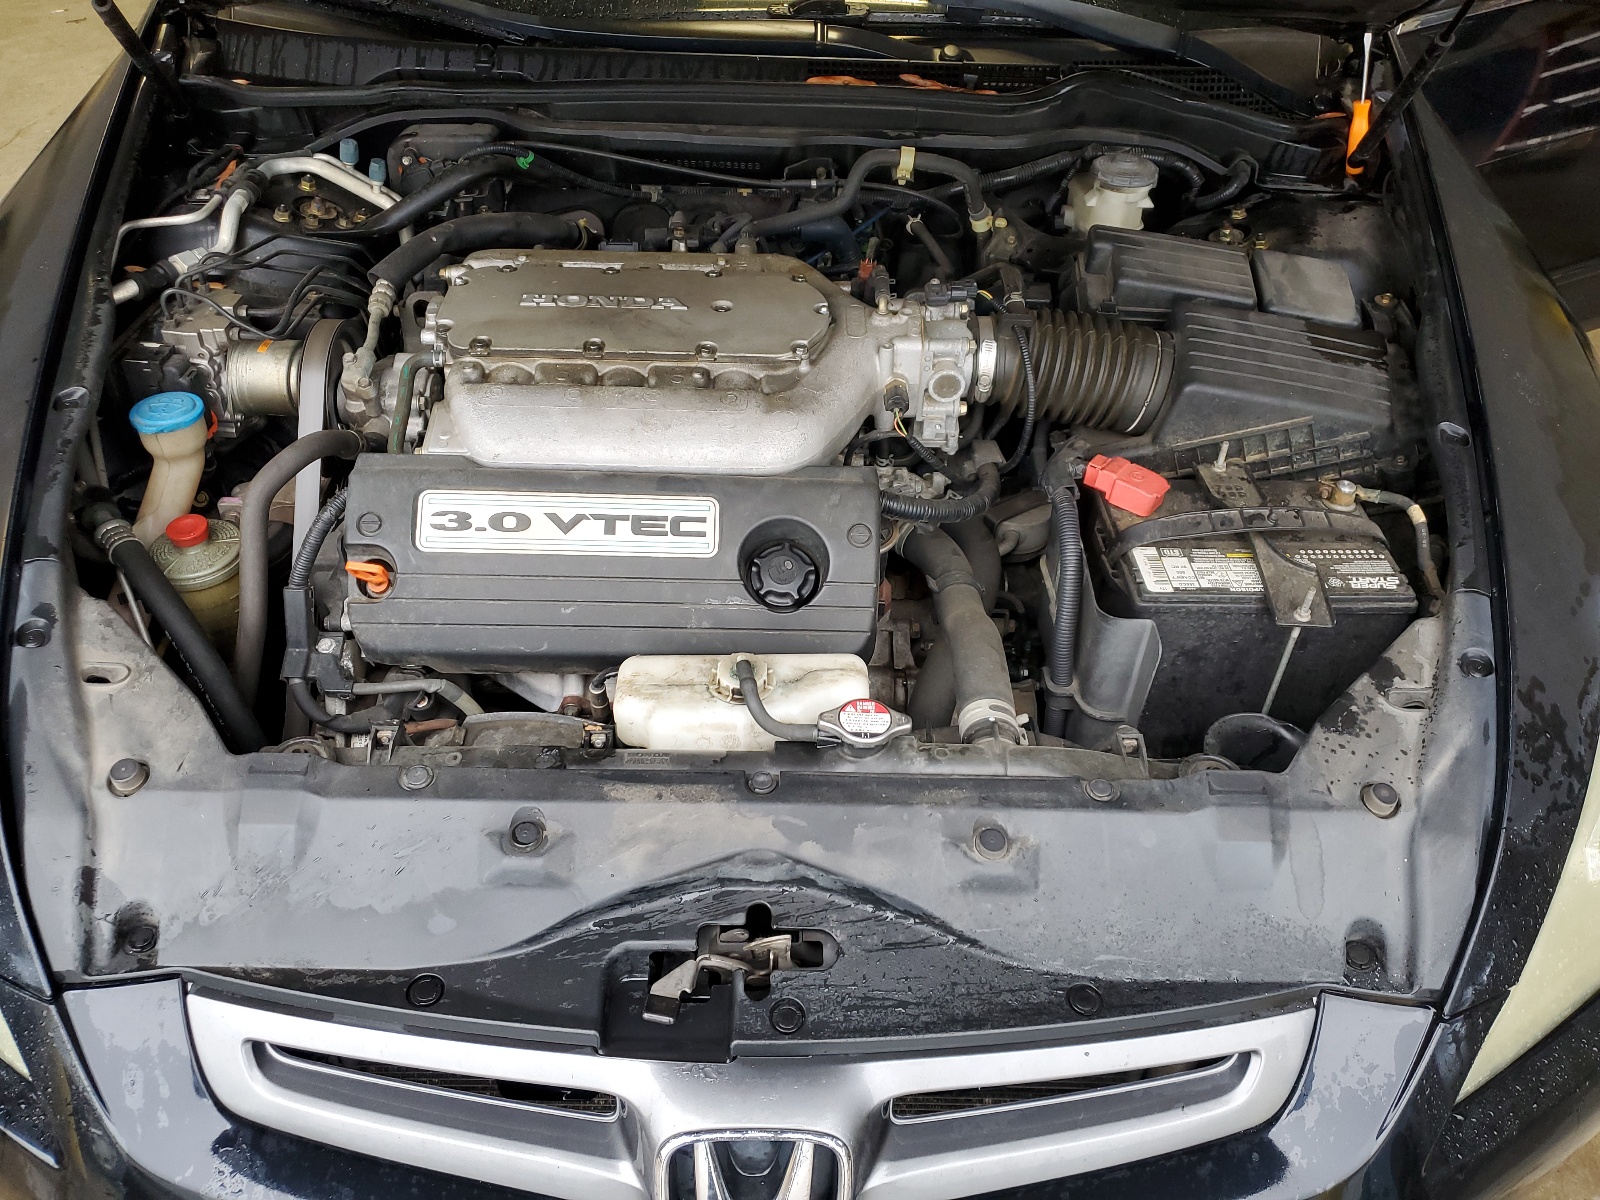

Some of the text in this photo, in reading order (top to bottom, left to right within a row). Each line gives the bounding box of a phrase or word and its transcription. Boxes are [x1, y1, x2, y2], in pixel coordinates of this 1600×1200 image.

[519, 293, 688, 311] HONDA
[429, 510, 707, 538] 3.0 VTEC
[1349, 576, 1400, 584] START
[1351, 581, 1398, 590] SUPER
